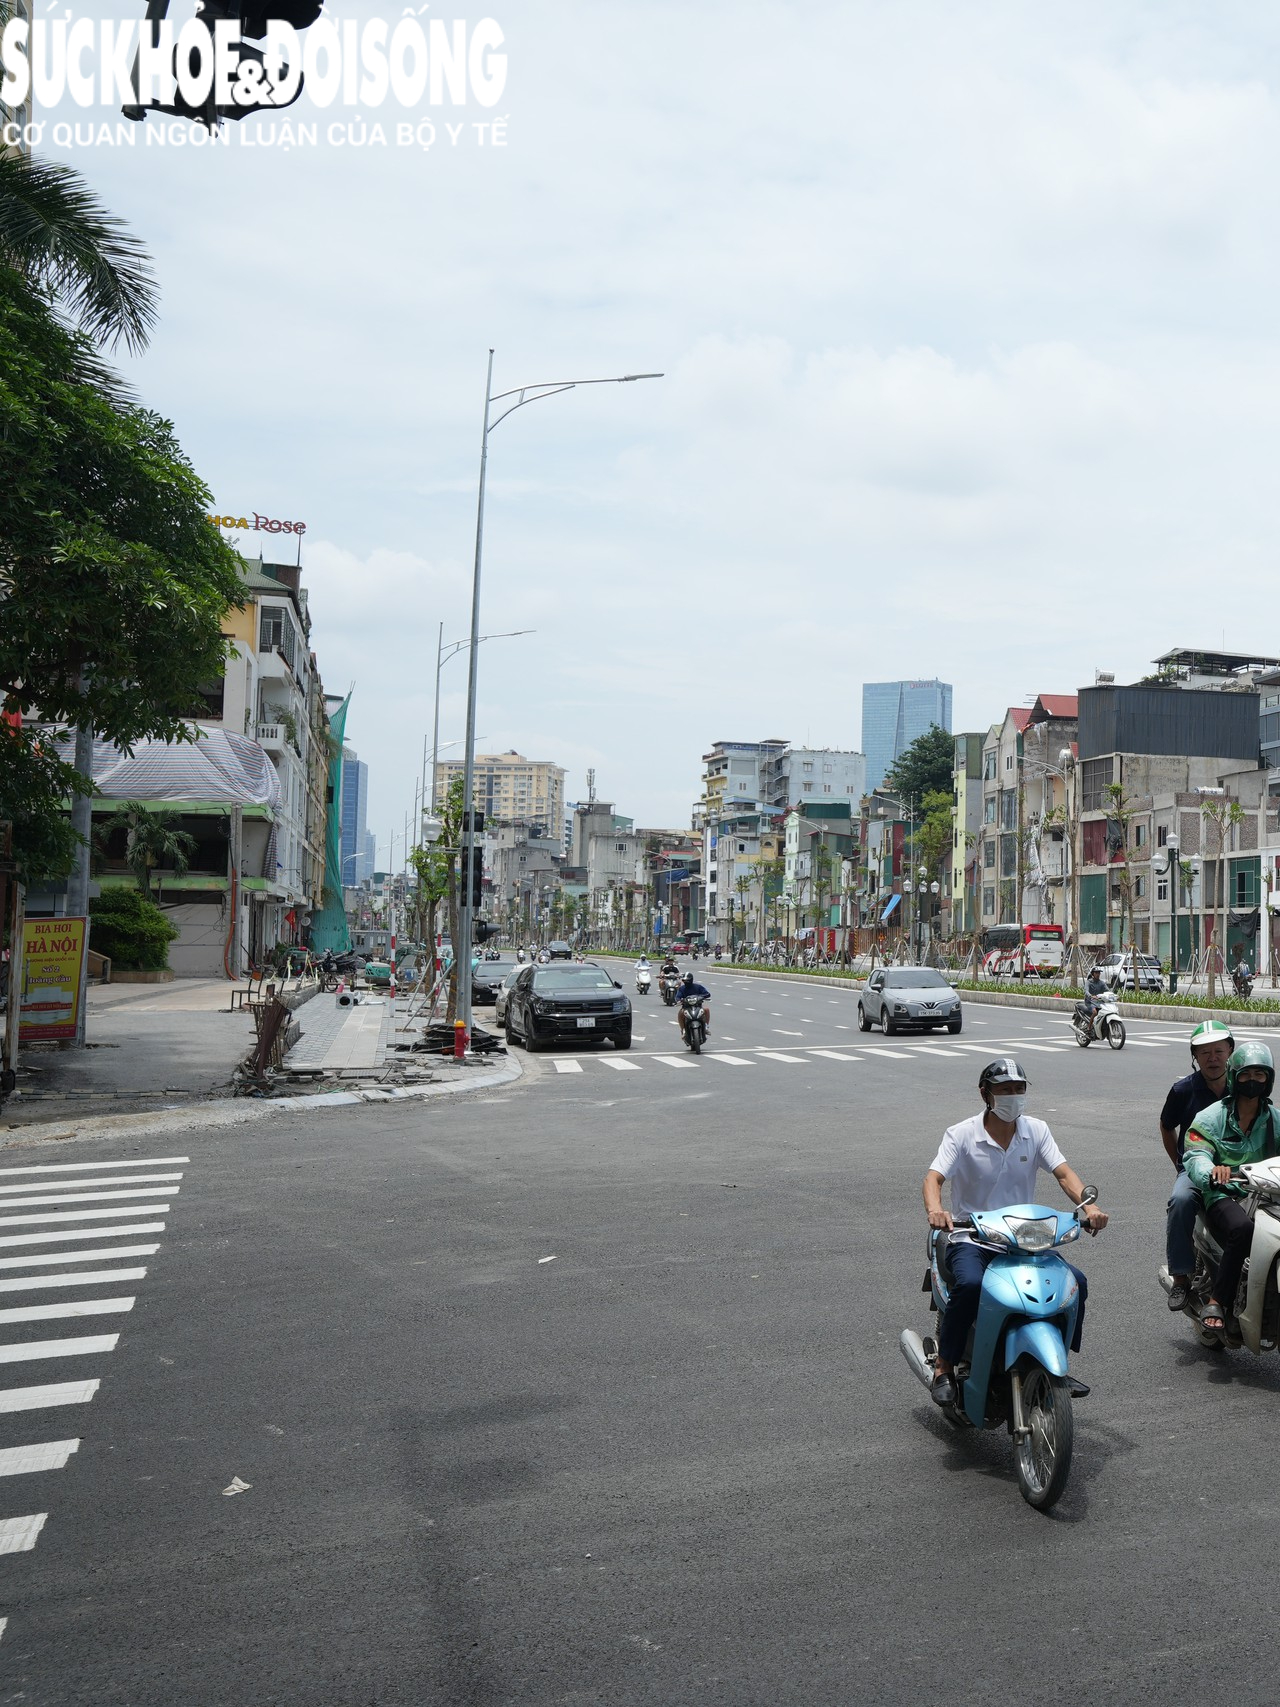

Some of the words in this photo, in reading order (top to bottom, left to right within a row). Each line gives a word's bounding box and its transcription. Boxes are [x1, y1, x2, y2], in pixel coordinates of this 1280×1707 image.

[252, 512, 307, 535] Rose
[35, 925, 51, 934] BIA
[54, 923, 72, 934] HƠI
[25, 937, 48, 954] HÀ
[50, 936, 78, 955] NỘI
